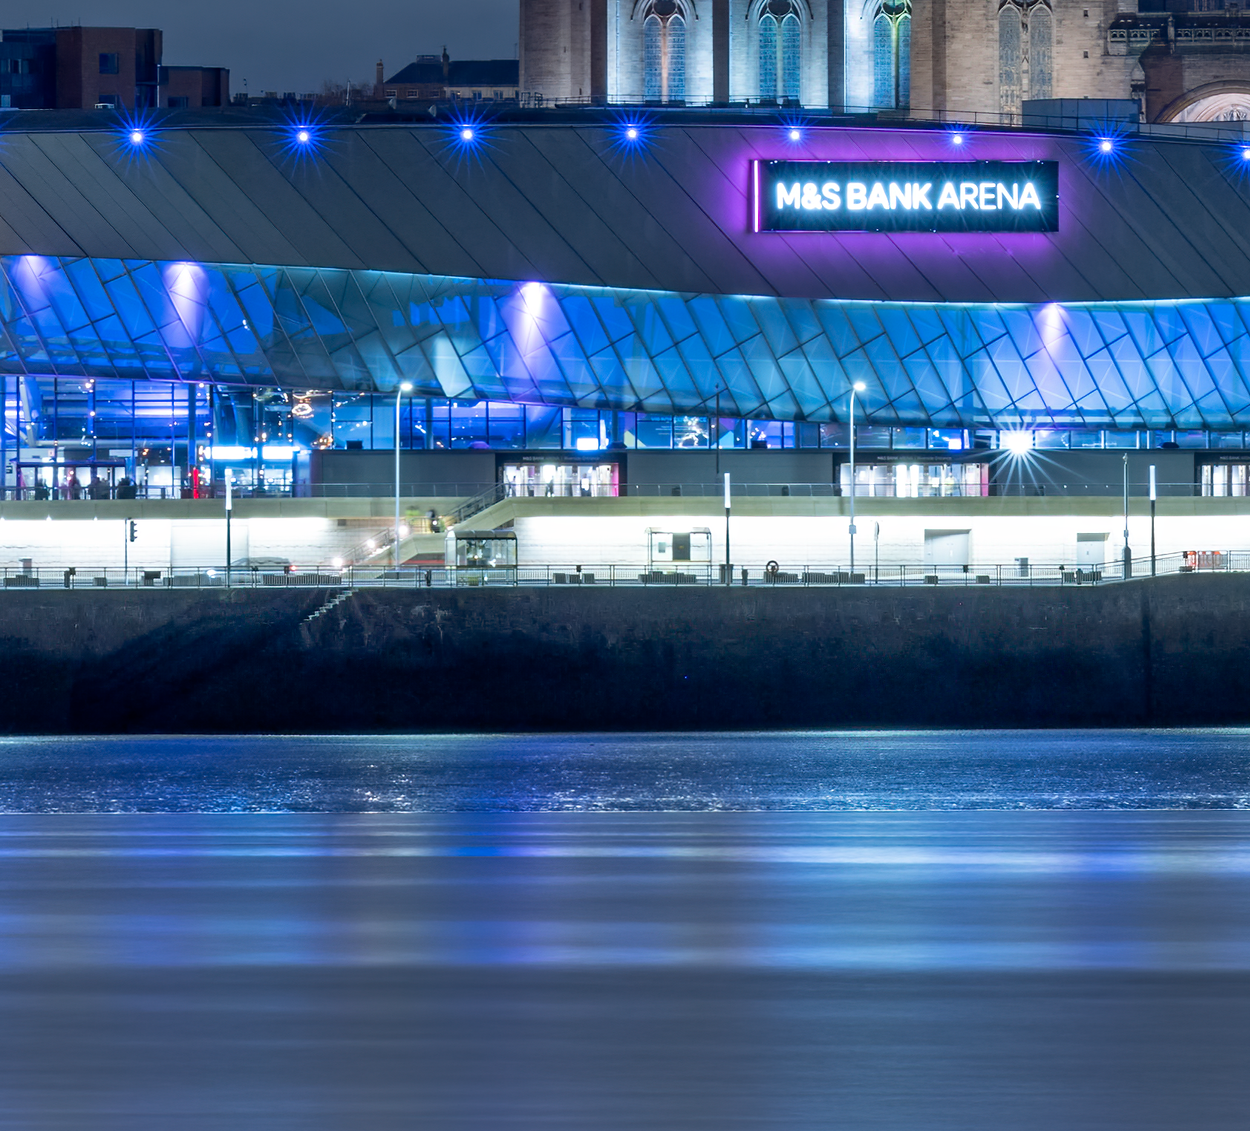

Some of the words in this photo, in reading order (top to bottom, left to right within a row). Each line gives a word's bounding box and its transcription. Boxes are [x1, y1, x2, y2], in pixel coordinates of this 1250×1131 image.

[776, 181, 841, 210] M&S
[846, 181, 933, 210] BANK
[937, 181, 1042, 210] ARENA
